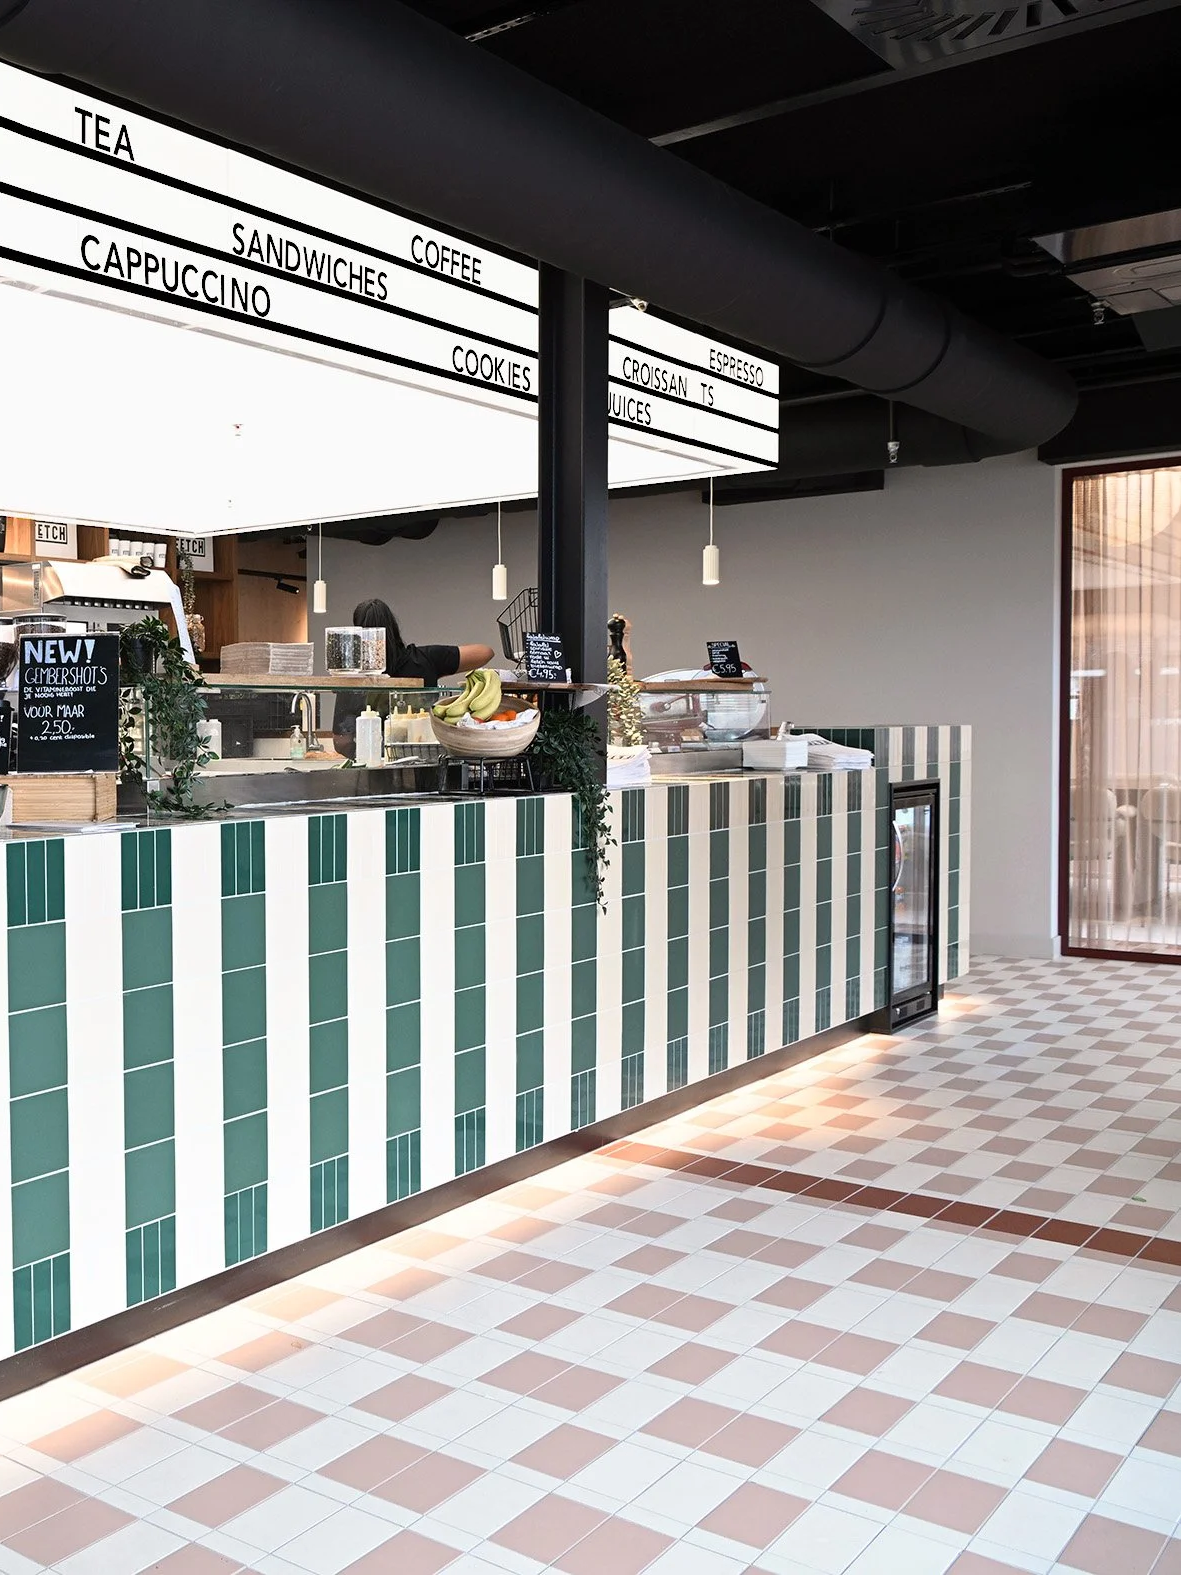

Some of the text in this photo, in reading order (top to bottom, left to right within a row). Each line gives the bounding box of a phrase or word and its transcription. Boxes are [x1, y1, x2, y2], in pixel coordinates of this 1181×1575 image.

[74, 107, 135, 162] TEA
[80, 234, 271, 318] CAPPUCCINO
[232, 222, 388, 301] SANDWICHES
[411, 235, 482, 286] COFFEE
[452, 345, 531, 392] COOKIES
[622, 356, 714, 407] CROISSAN TS
[709, 348, 764, 388] ESPRESSO
[608, 391, 652, 426] JUICES
[35, 523, 66, 541] ETCH
[176, 537, 204, 554] ETCH
[24, 639, 96, 664] NEW!
[56, 704, 85, 718] MAAR
